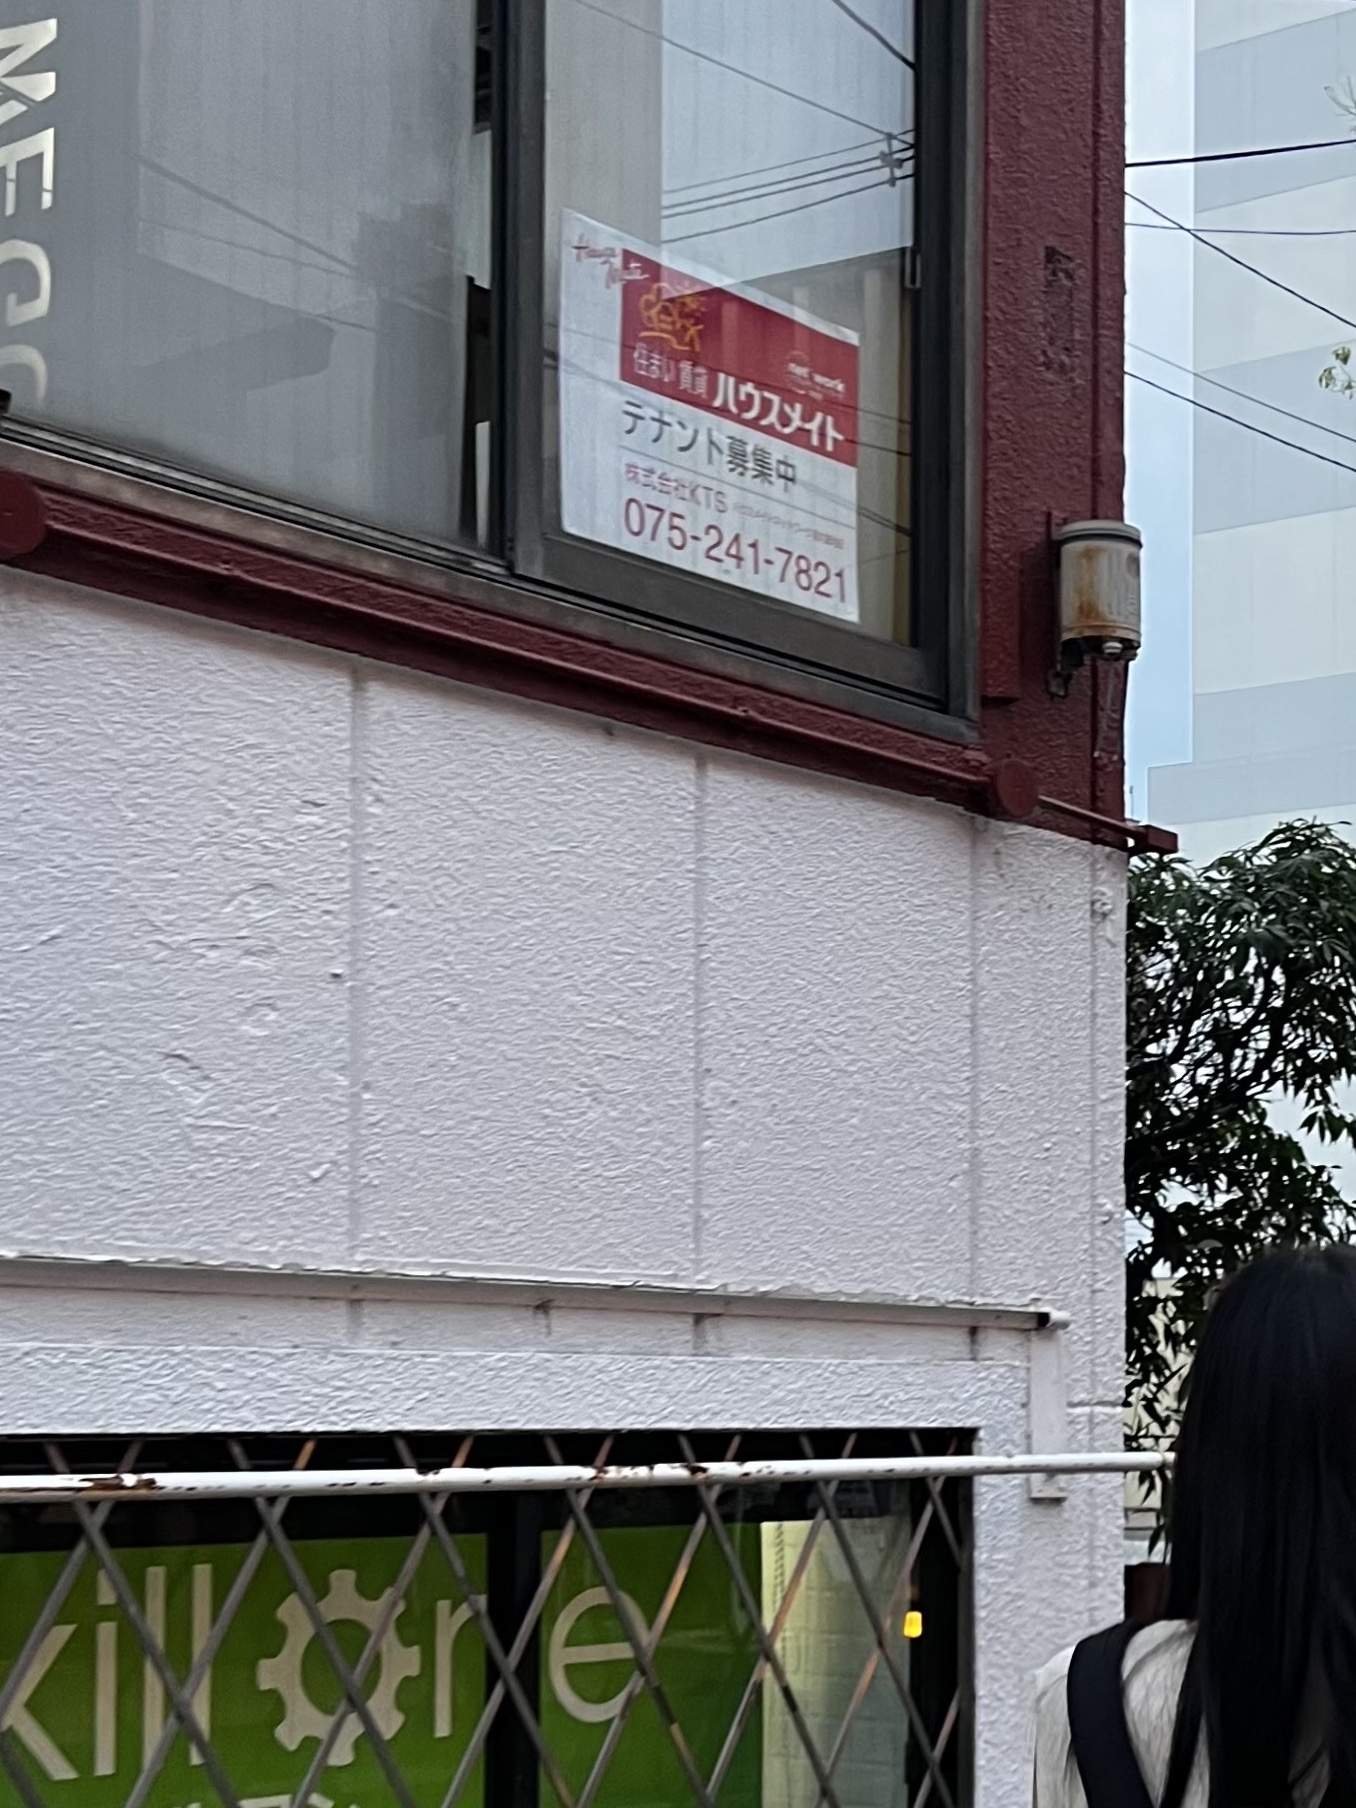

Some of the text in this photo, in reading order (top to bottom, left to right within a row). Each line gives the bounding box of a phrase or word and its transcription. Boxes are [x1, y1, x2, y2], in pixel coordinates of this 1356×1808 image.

[621, 401, 797, 494] テナント募集中
[713, 372, 845, 452] ハウスメイト
[624, 498, 846, 604] 075-241-7821
